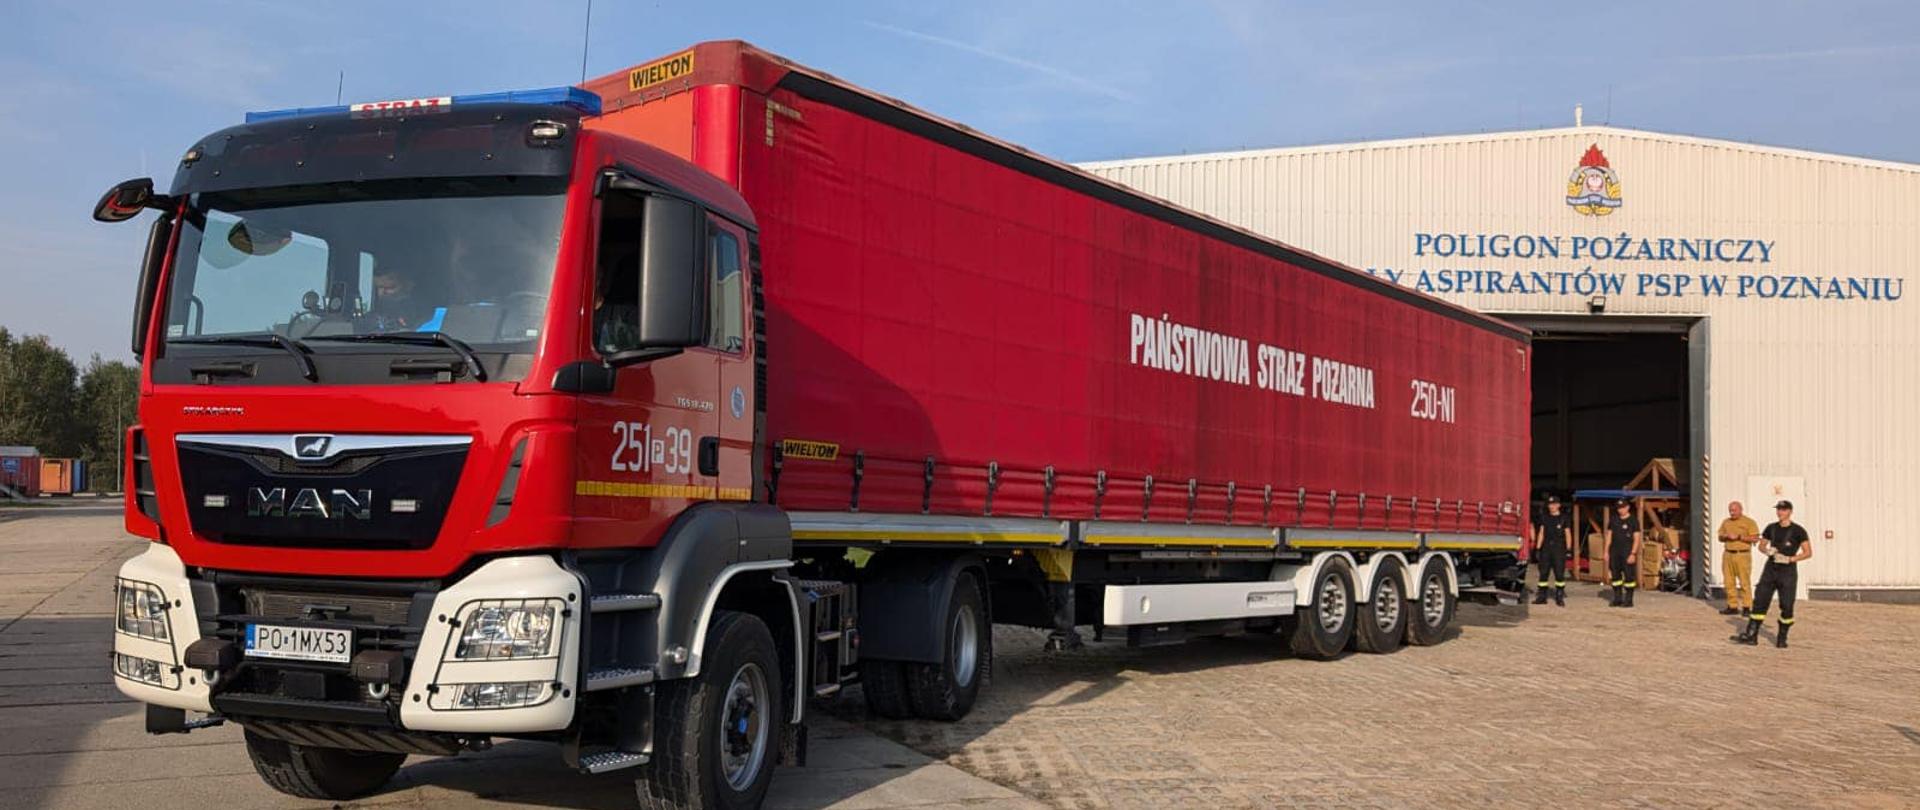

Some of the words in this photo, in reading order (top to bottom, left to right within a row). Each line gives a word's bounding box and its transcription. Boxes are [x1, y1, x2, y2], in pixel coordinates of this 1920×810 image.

[632, 54, 692, 89] WIELTON
[1415, 232, 1560, 259] POLIGON
[1570, 232, 1775, 263] POŻARNICZY
[1415, 266, 1626, 296] ASPIRANTÓW
[1637, 273, 1691, 297] PSP
[1699, 275, 1728, 297] W
[1737, 275, 1904, 301] POZNANIU
[1130, 313, 1250, 386] PAŃSTWOWA
[1257, 343, 1306, 396] STRAŻ
[1312, 356, 1375, 409] POŻARNA
[1410, 379, 1455, 424] 250-N1
[785, 441, 837, 458] WIELTON
[248, 487, 371, 520] MAN
